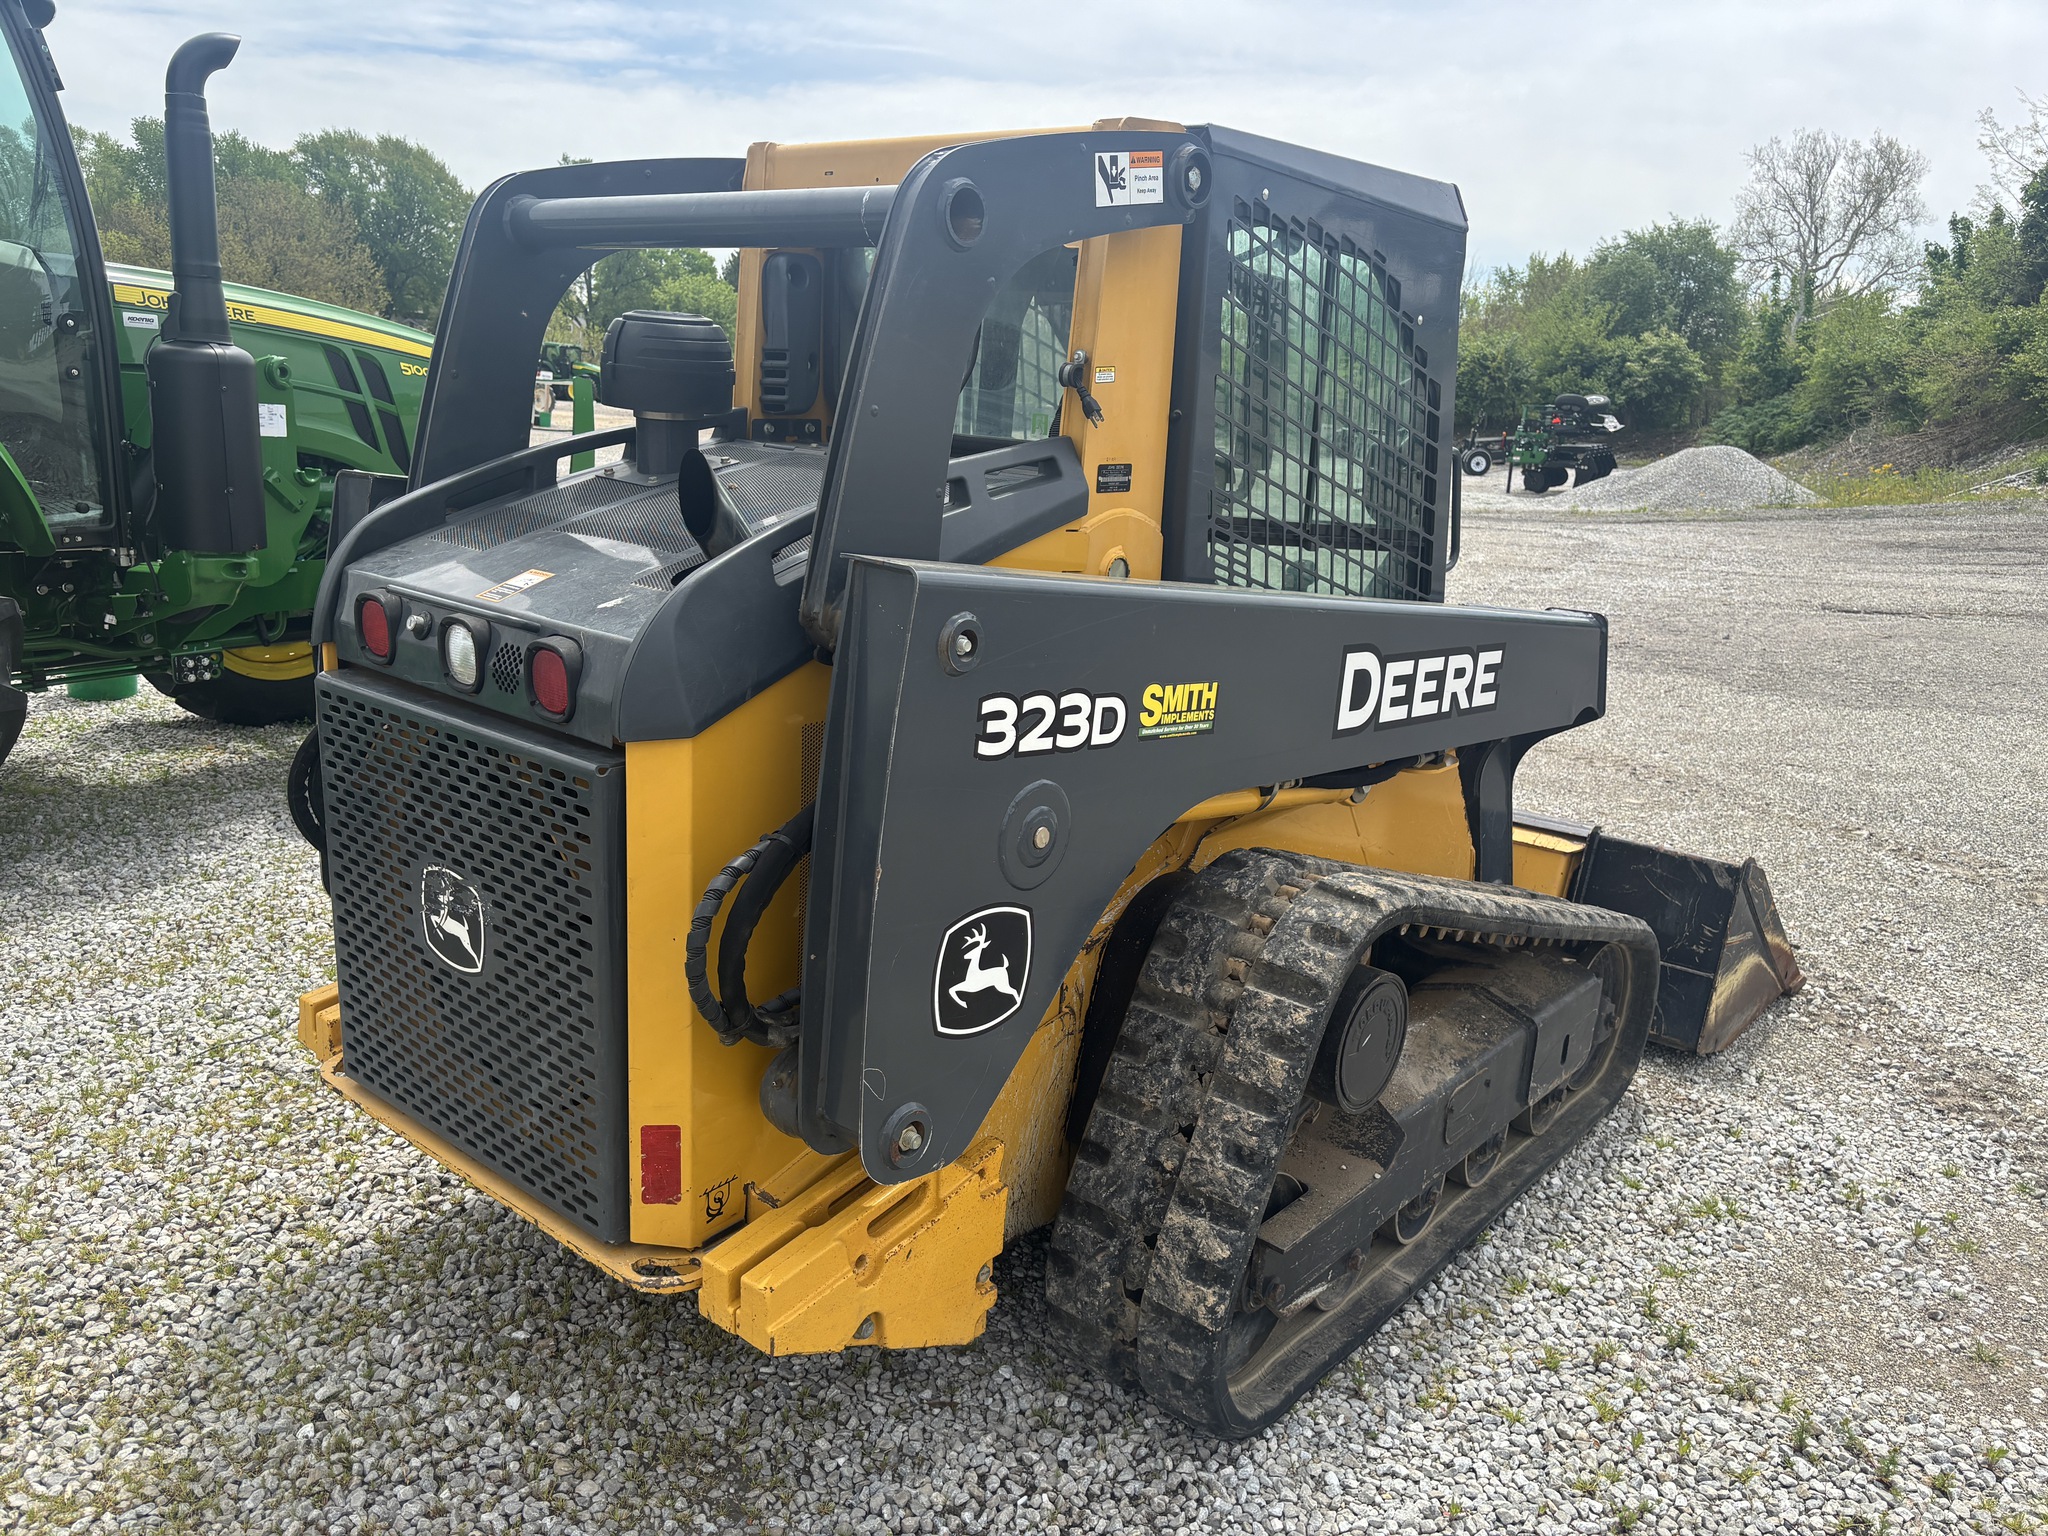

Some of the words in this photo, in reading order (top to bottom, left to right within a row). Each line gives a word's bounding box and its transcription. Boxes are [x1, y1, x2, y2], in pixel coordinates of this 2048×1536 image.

[136, 290, 168, 309] JOH
[1140, 681, 1218, 726] SMITH
[1337, 650, 1503, 731] DEERE
[977, 692, 1127, 756] 323D
[1160, 709, 1215, 725] IMPLEMENTS
